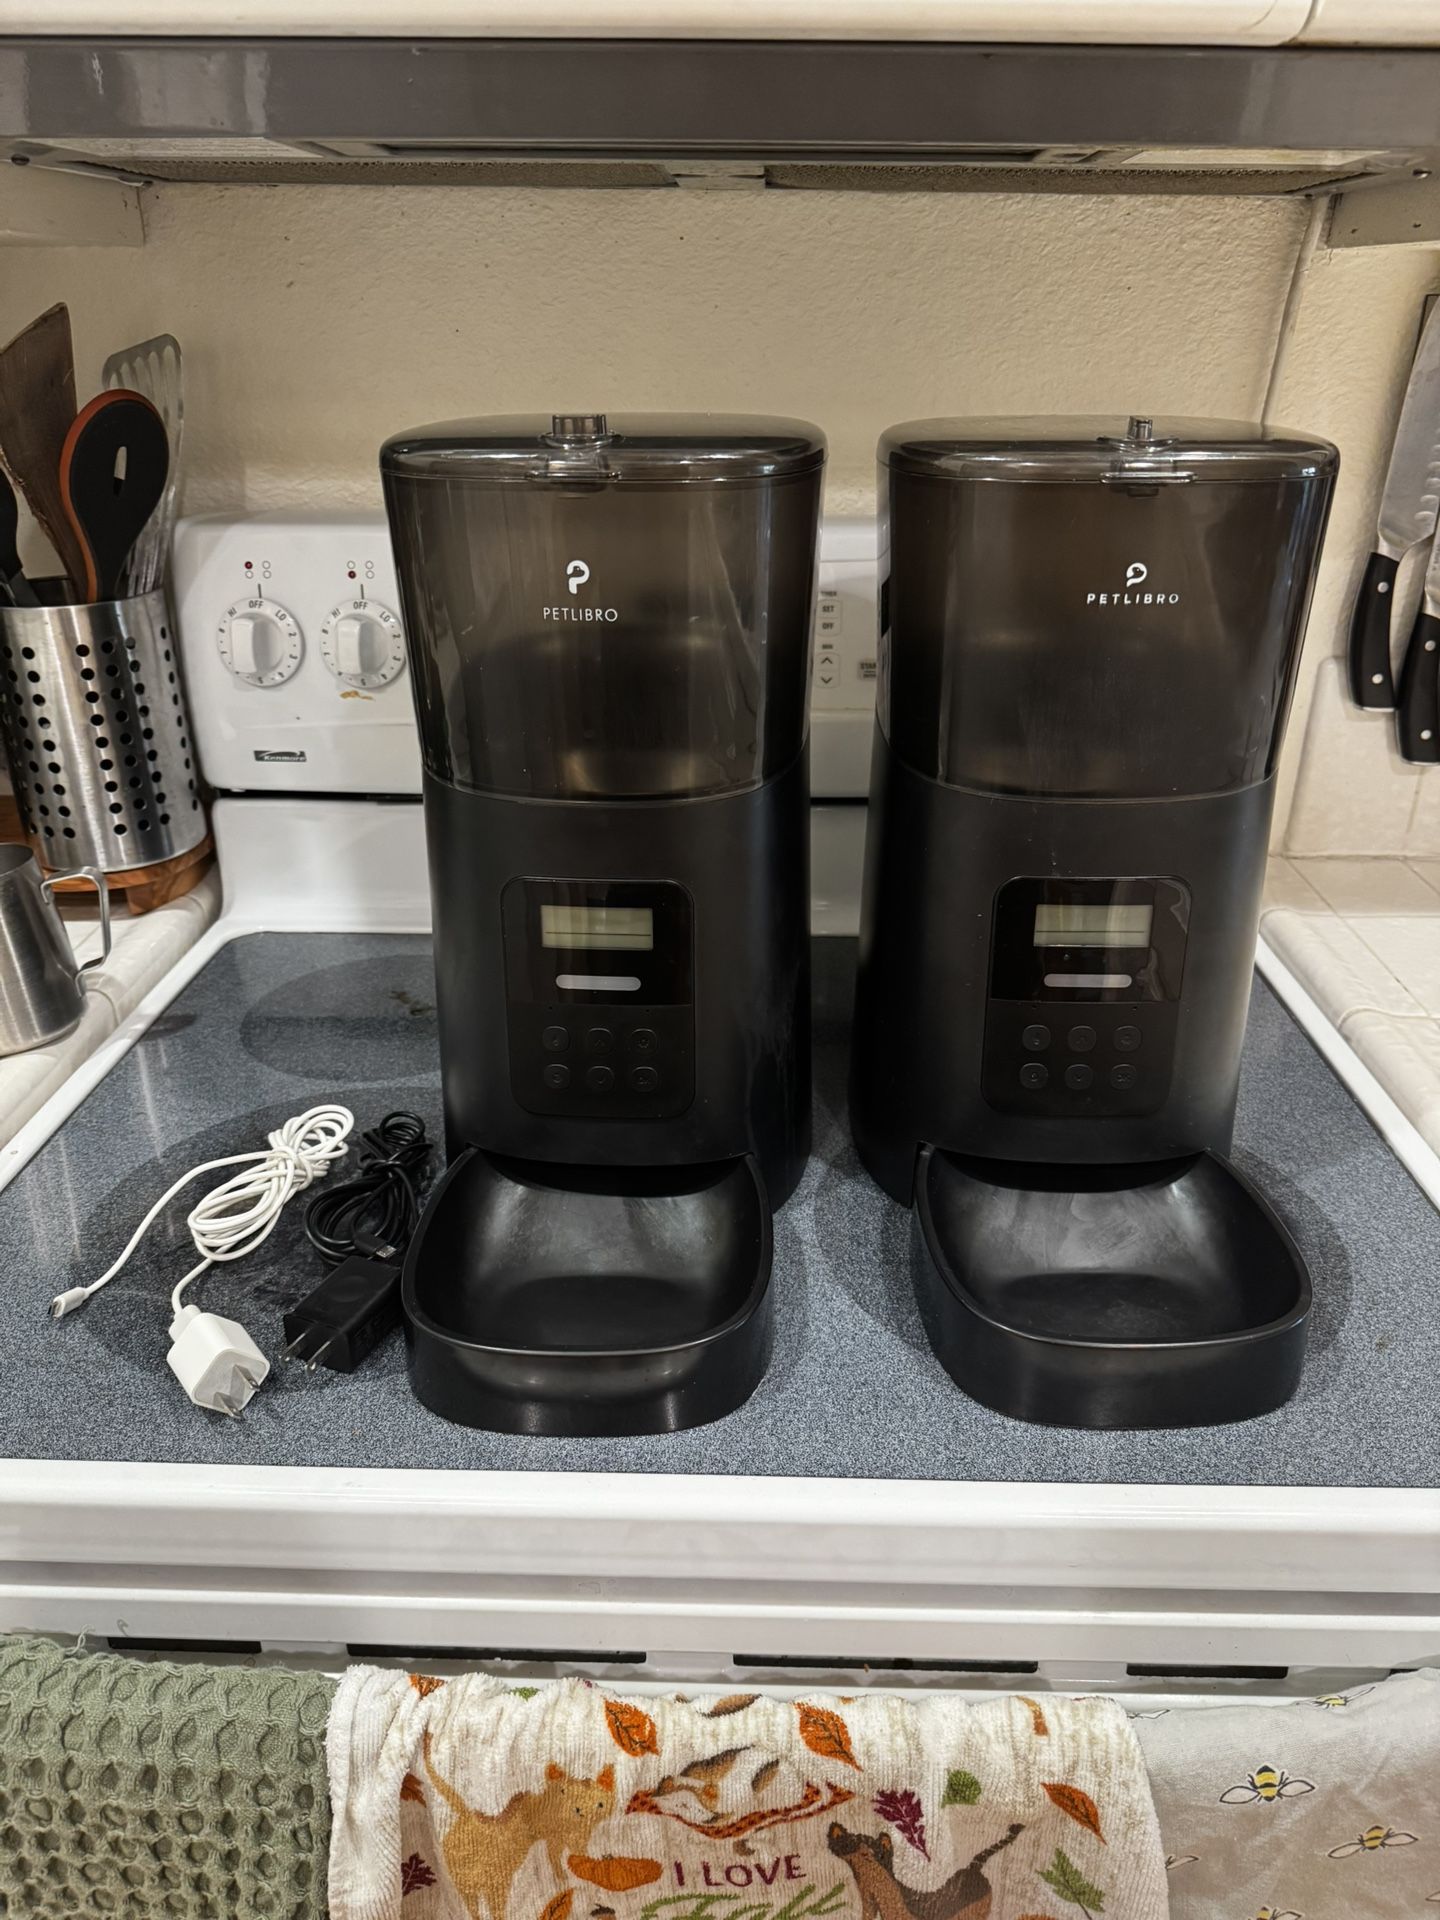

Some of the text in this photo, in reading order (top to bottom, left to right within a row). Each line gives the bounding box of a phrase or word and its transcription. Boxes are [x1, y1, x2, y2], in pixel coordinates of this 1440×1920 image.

[248, 600, 264, 609] OFF
[1086, 593, 1179, 605] PETLIBRO
[353, 601, 368, 610] OFF
[822, 605, 834, 613] SET
[275, 609, 287, 621] LO
[379, 611, 391, 622] LO
[543, 607, 618, 622] PETLIBRO
[674, 1854, 806, 1888] I LOVE
